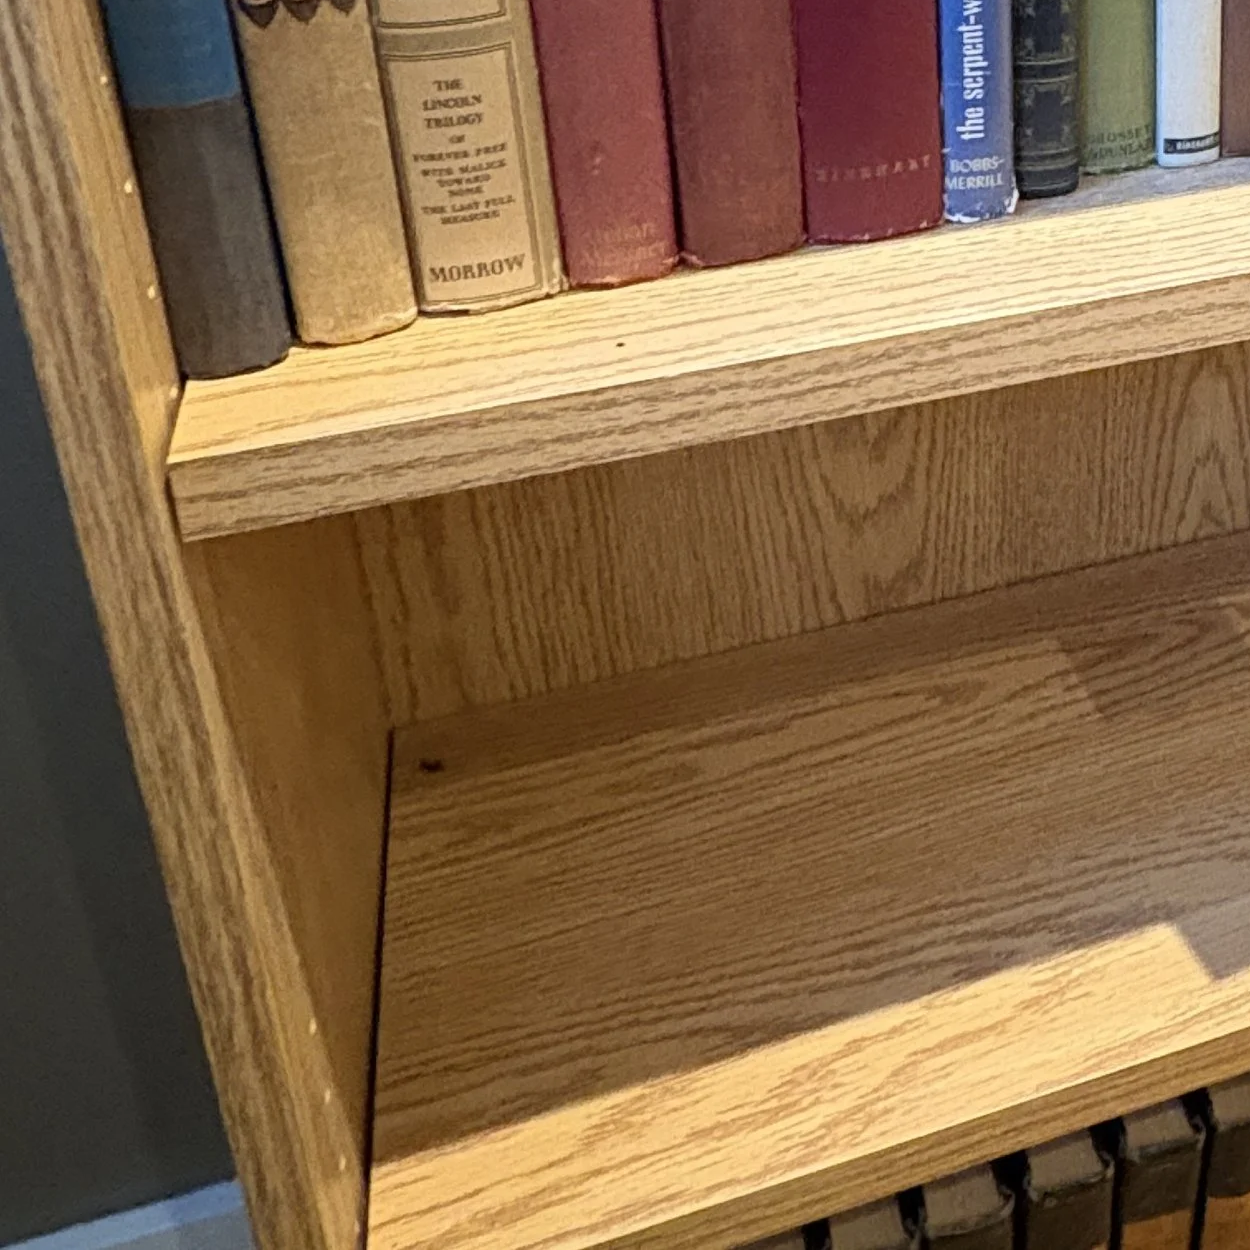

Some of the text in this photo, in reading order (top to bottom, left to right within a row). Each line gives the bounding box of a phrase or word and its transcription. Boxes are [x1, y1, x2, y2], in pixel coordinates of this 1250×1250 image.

[432, 78, 463, 92] THE
[422, 94, 482, 112] LINCOLN
[424, 113, 484, 129] TRILOGY
[956, 106, 985, 140] the
[428, 253, 527, 283] MORROW
